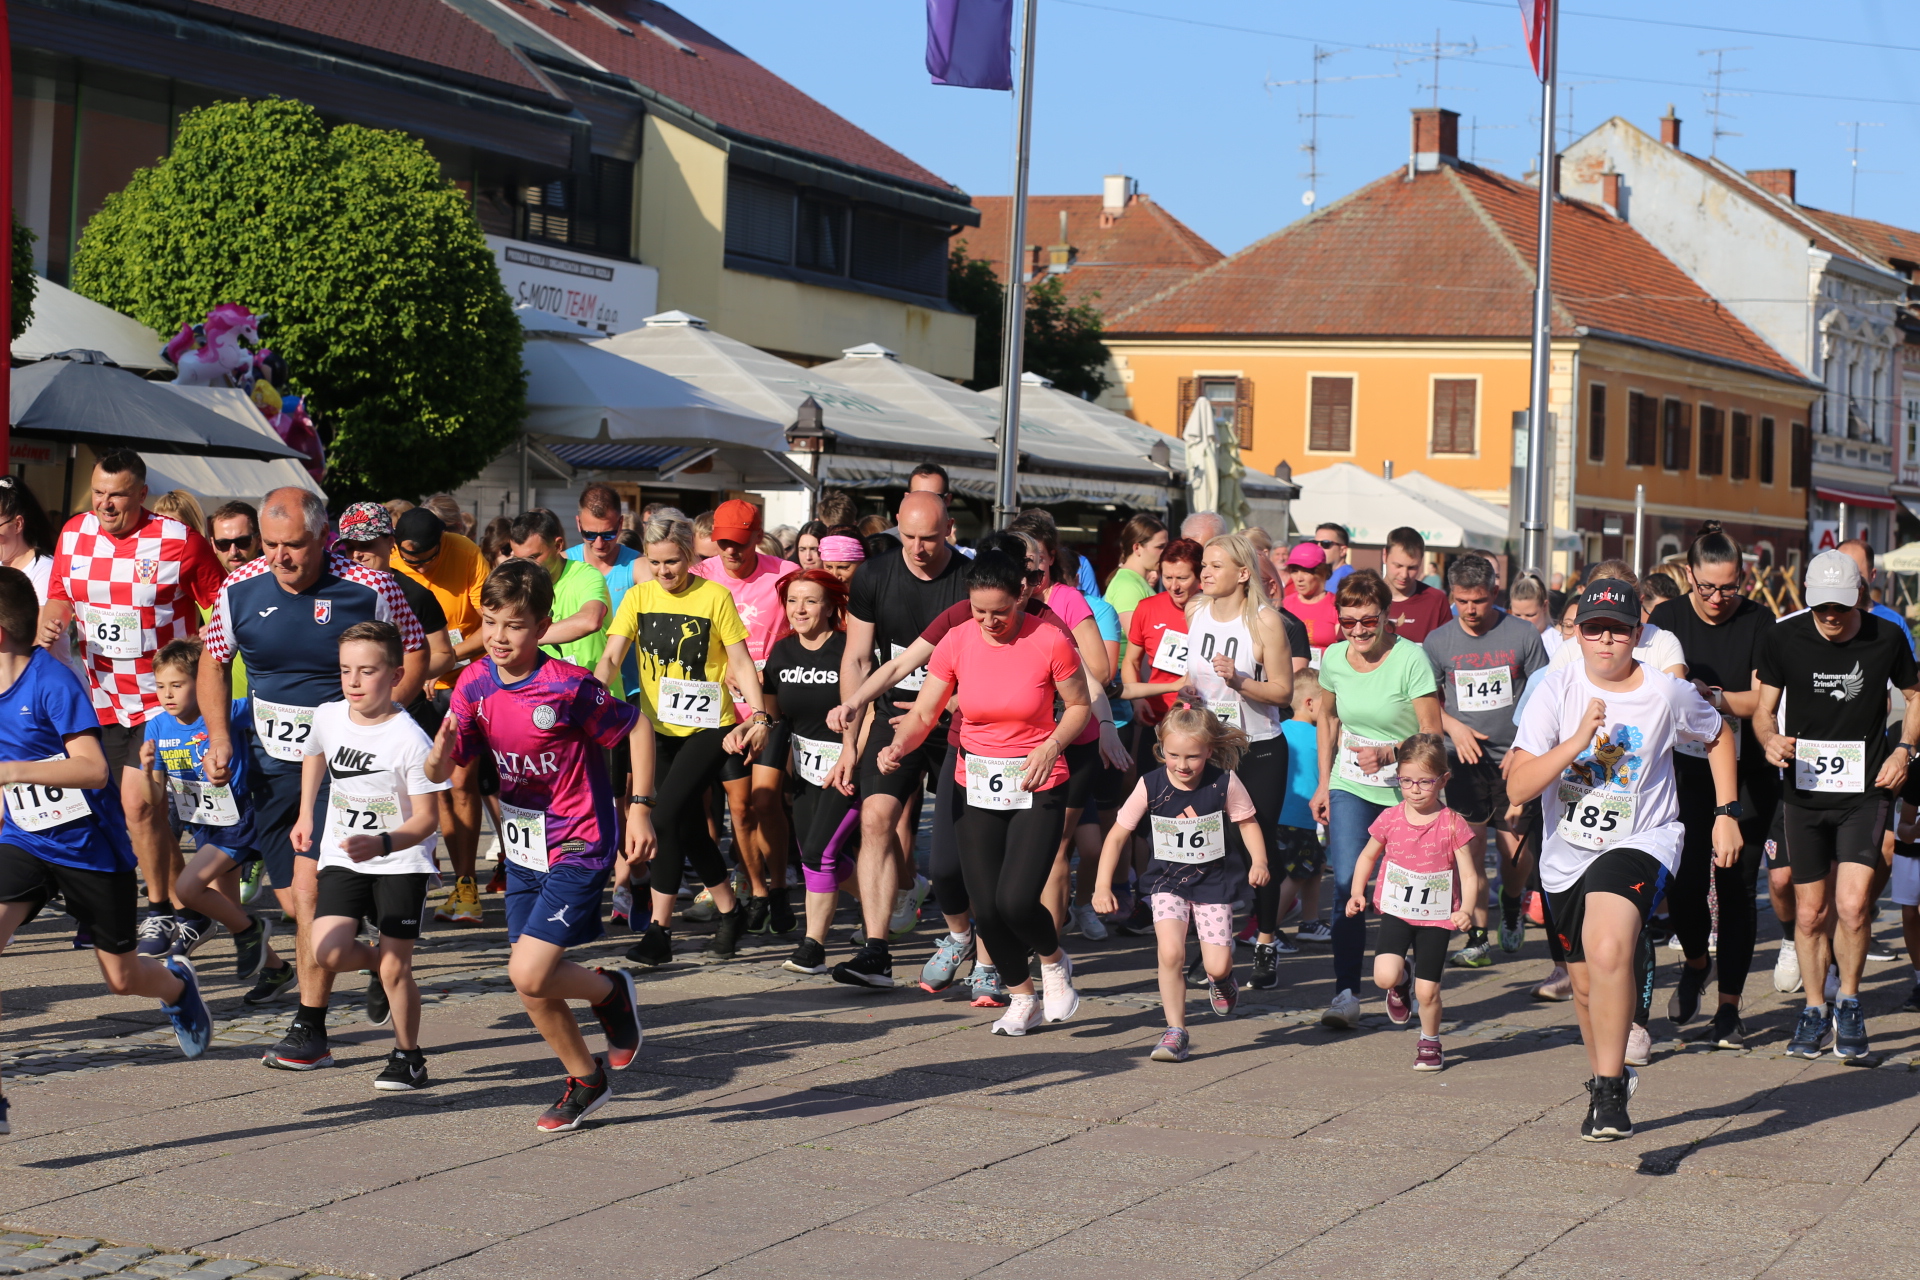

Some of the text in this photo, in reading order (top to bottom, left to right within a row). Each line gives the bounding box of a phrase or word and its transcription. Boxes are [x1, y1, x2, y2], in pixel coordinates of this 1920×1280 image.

[516, 281, 563, 313] S-MOTO
[565, 289, 598, 319] TEAM
[97, 622, 121, 642] 63
[779, 666, 839, 684] adidas
[1813, 672, 1857, 680] Polumaraton
[1813, 680, 1837, 688] Zrinski
[1467, 680, 1502, 697] 144
[671, 692, 711, 713] 172
[266, 719, 312, 744] 122
[334, 745, 377, 771] NIKE
[803, 751, 822, 771] 71
[1814, 756, 1845, 775] 59
[989, 773, 1003, 792] 6
[13, 784, 64, 810] 116
[191, 792, 214, 810] 15
[349, 795, 367, 803] GRADA
[367, 795, 395, 804] ČAKOVCA
[1584, 788, 1605, 799] GRADA
[1605, 792, 1633, 803] ČAKOVCA
[346, 808, 379, 830] 72
[516, 807, 541, 820] ČAKOVCA
[1197, 814, 1220, 824] ČAKOVCA
[1566, 801, 1620, 832] 185
[1175, 830, 1205, 849] 16
[1410, 873, 1427, 881] GRADA
[1403, 885, 1431, 905] 11
[1643, 969, 1654, 1009] adidas
